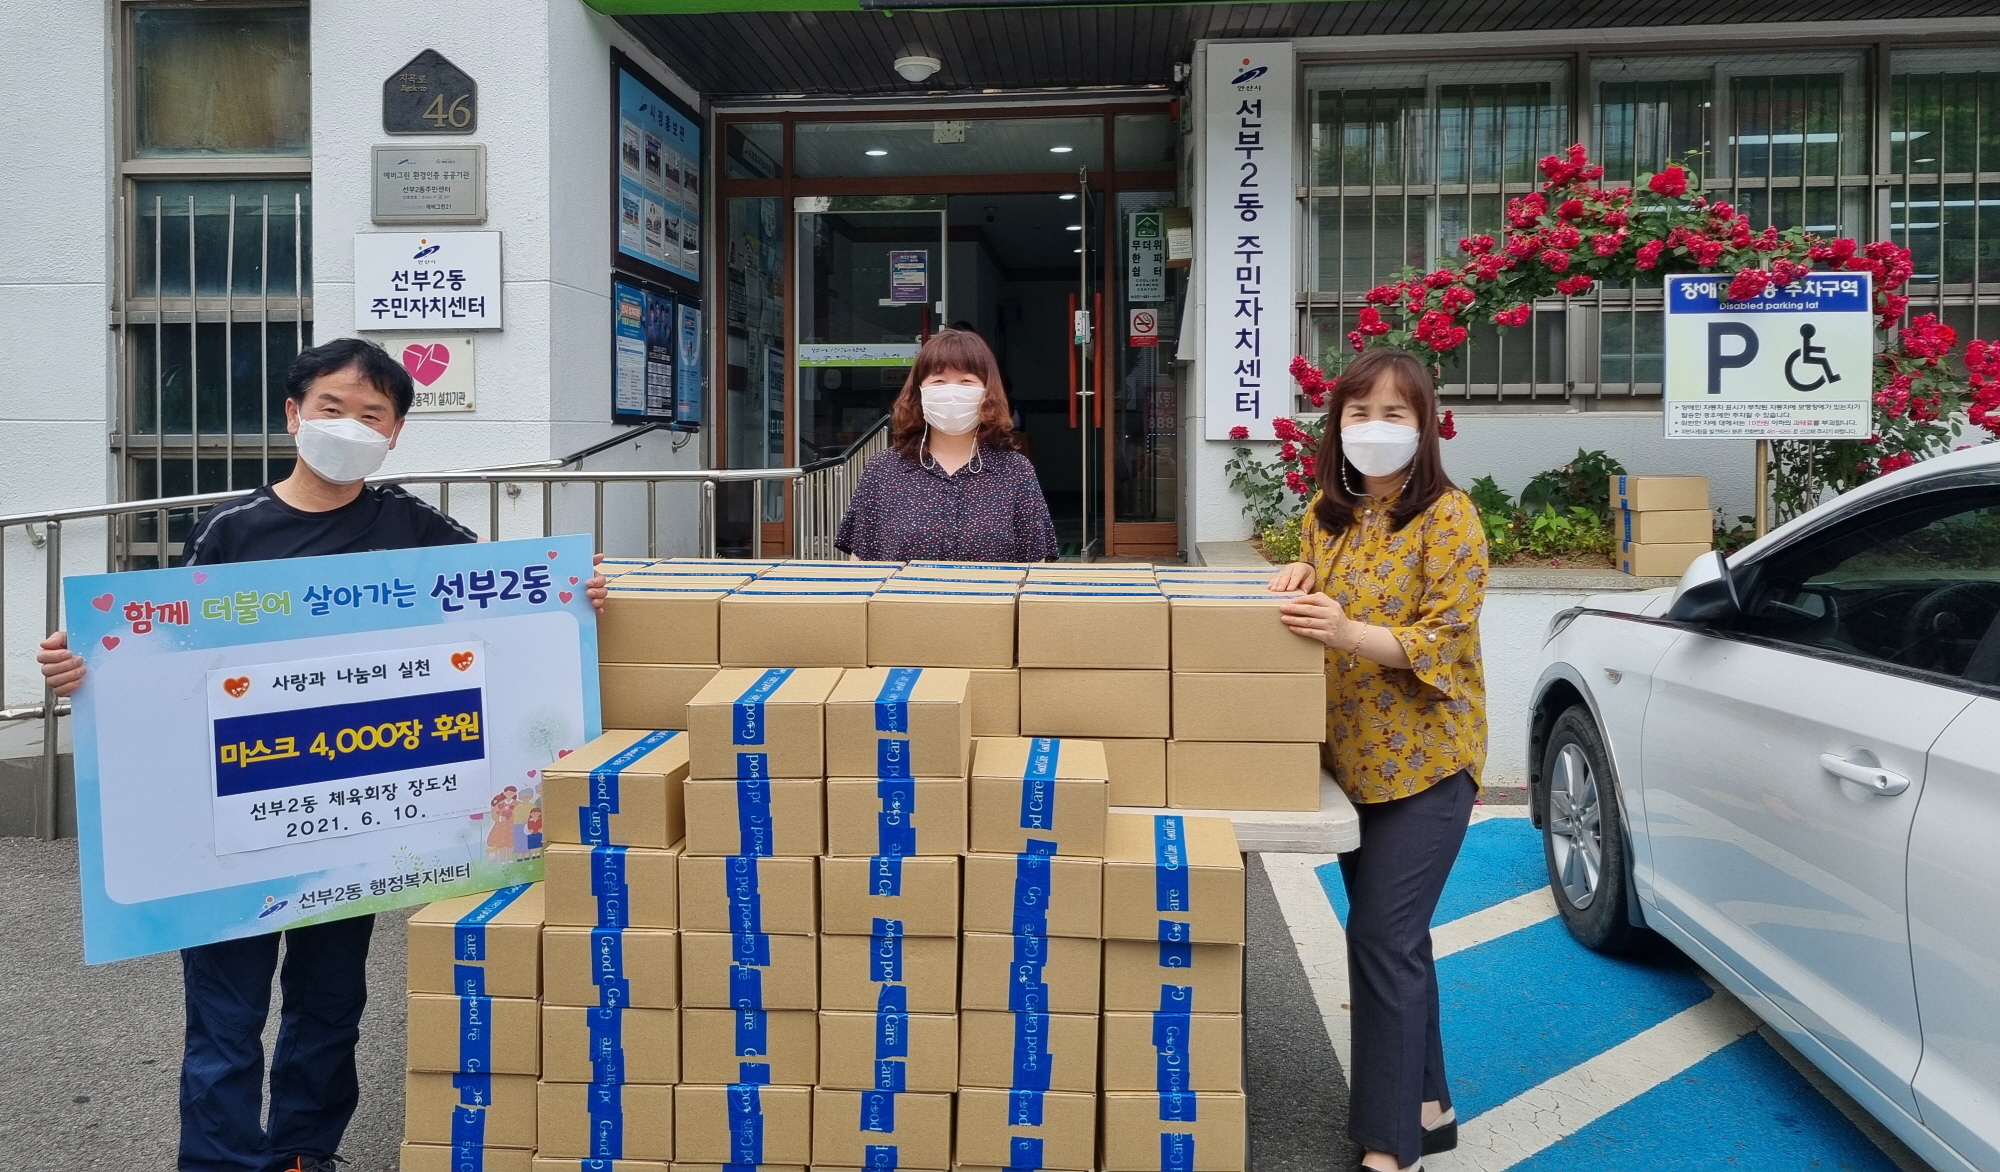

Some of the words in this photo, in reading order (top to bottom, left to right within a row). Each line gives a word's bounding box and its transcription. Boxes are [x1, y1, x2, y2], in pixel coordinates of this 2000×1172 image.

[422, 93, 471, 127] 46
[383, 172, 410, 180] 에버그린
[413, 171, 440, 180] 환경인증
[442, 171, 470, 180] 공공기관
[1233, 99, 1264, 222] 선부2동
[1132, 240, 1162, 251] 무더위
[391, 269, 466, 292] 선부2동
[1784, 280, 1858, 298] 주차구역
[371, 296, 485, 319] 주민자치센터
[1719, 301, 1763, 311] Disabled
[1766, 301, 1804, 311] parking
[1233, 235, 1264, 419] 주민자치센터
[1707, 321, 1759, 394] P
[438, 392, 466, 407] 설치기관
[123, 600, 190, 635] 함께
[202, 590, 291, 626] 더불어
[303, 578, 418, 616] 살아가는
[429, 564, 552, 613] 선부2동
[272, 671, 326, 692] 사랑과
[337, 664, 388, 685] 나눔의
[398, 659, 431, 679] 실천
[220, 735, 300, 768] 마스크
[309, 718, 423, 760] 4,000장
[431, 711, 480, 742] 후원
[250, 794, 319, 821] 선부2동
[328, 782, 398, 806] 체육회장
[407, 774, 458, 797] 장도선
[1030, 781, 1045, 811] Care
[286, 817, 348, 838] 2021.
[361, 811, 381, 826] 6.
[394, 804, 426, 820] 10.
[298, 882, 363, 909] 선부2동
[369, 862, 471, 896] 행정복지센터
[885, 1015, 898, 1046] Care
